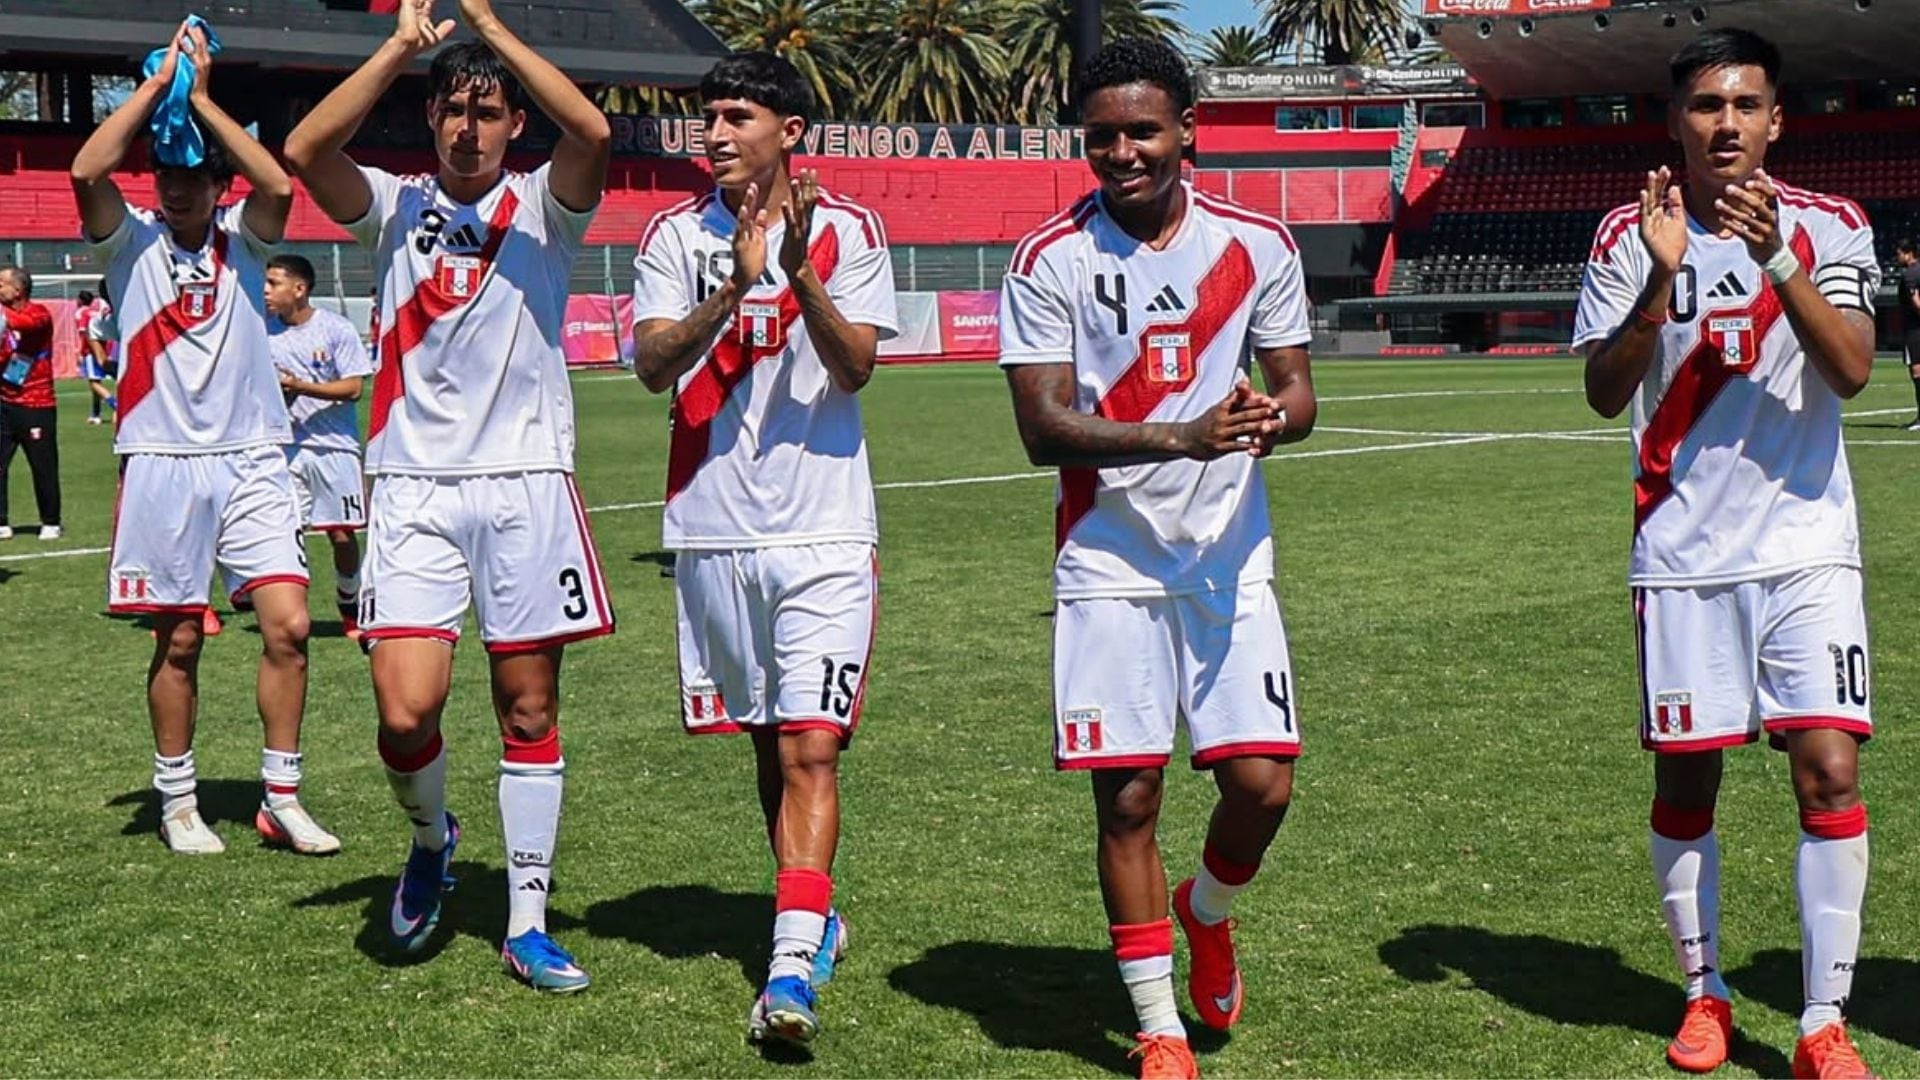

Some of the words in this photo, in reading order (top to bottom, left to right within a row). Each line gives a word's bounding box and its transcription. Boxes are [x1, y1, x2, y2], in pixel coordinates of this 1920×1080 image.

[803, 123, 919, 158] VENGO
[929, 126, 957, 159] A
[1094, 272, 1128, 336] 4
[1711, 319, 1750, 329] PERU
[341, 494, 362, 520] 14
[559, 567, 588, 621] 3
[820, 656, 861, 718] 15
[1264, 672, 1292, 733] 4
[1828, 643, 1866, 706] 10
